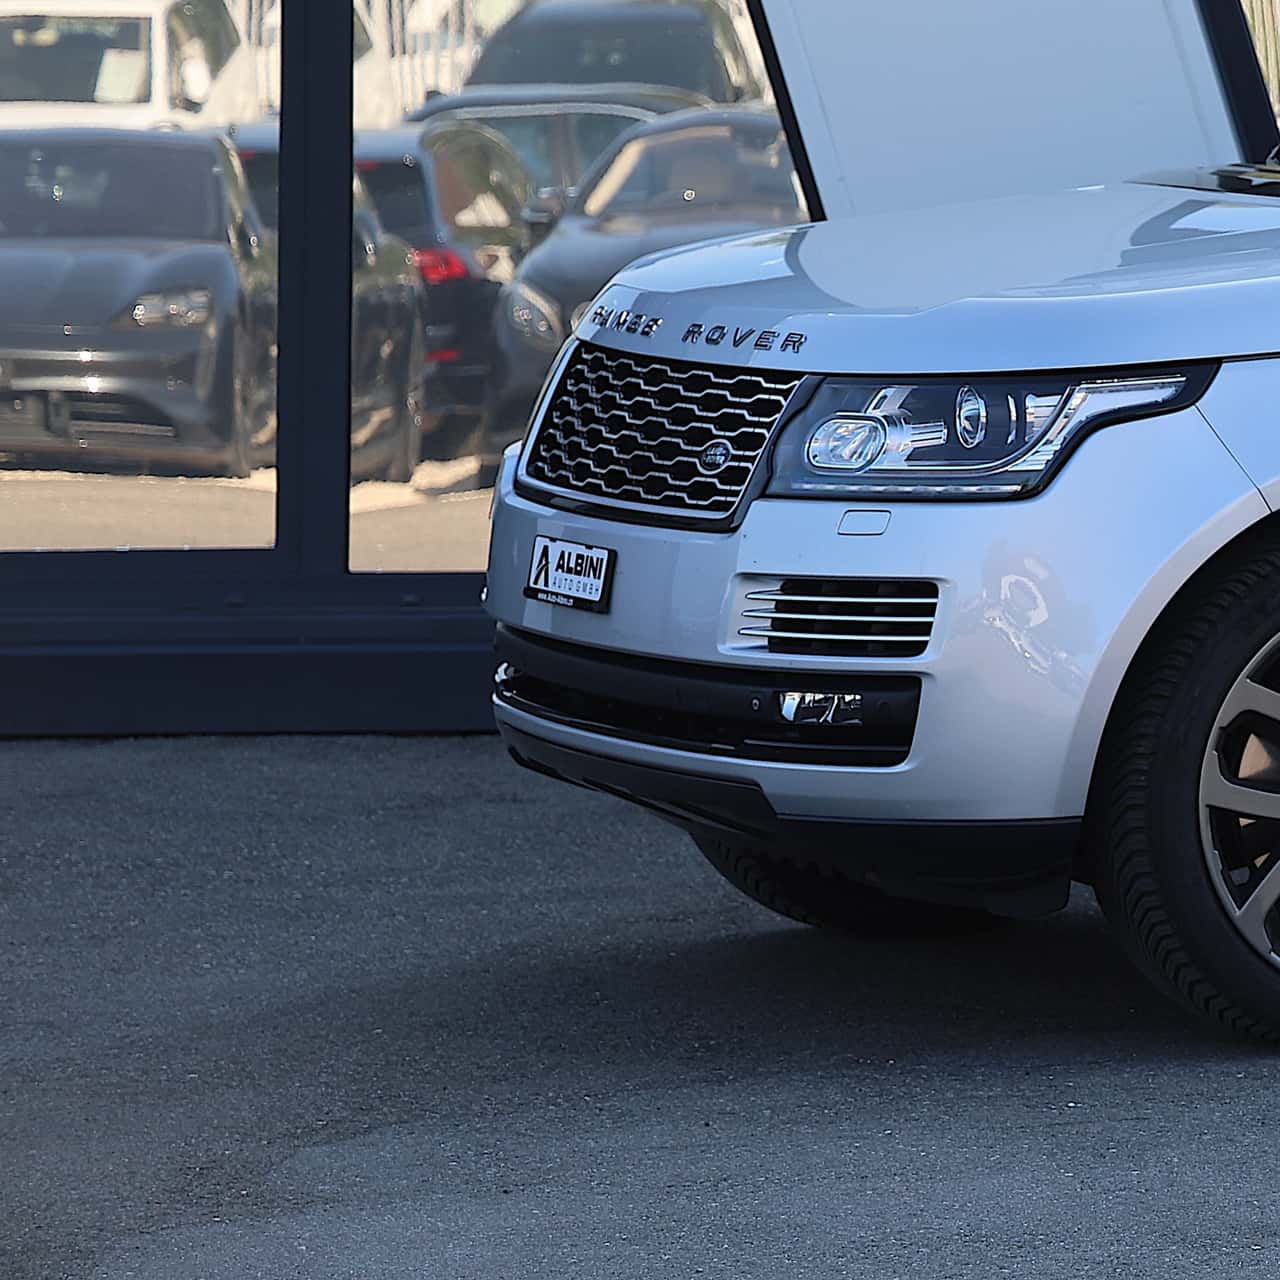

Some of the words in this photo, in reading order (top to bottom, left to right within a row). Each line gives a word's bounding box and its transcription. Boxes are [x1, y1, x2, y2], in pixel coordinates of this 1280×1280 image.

[681, 323, 807, 354] ROVER
[555, 550, 604, 580] ALBINI
[552, 575, 573, 591] AUTO
